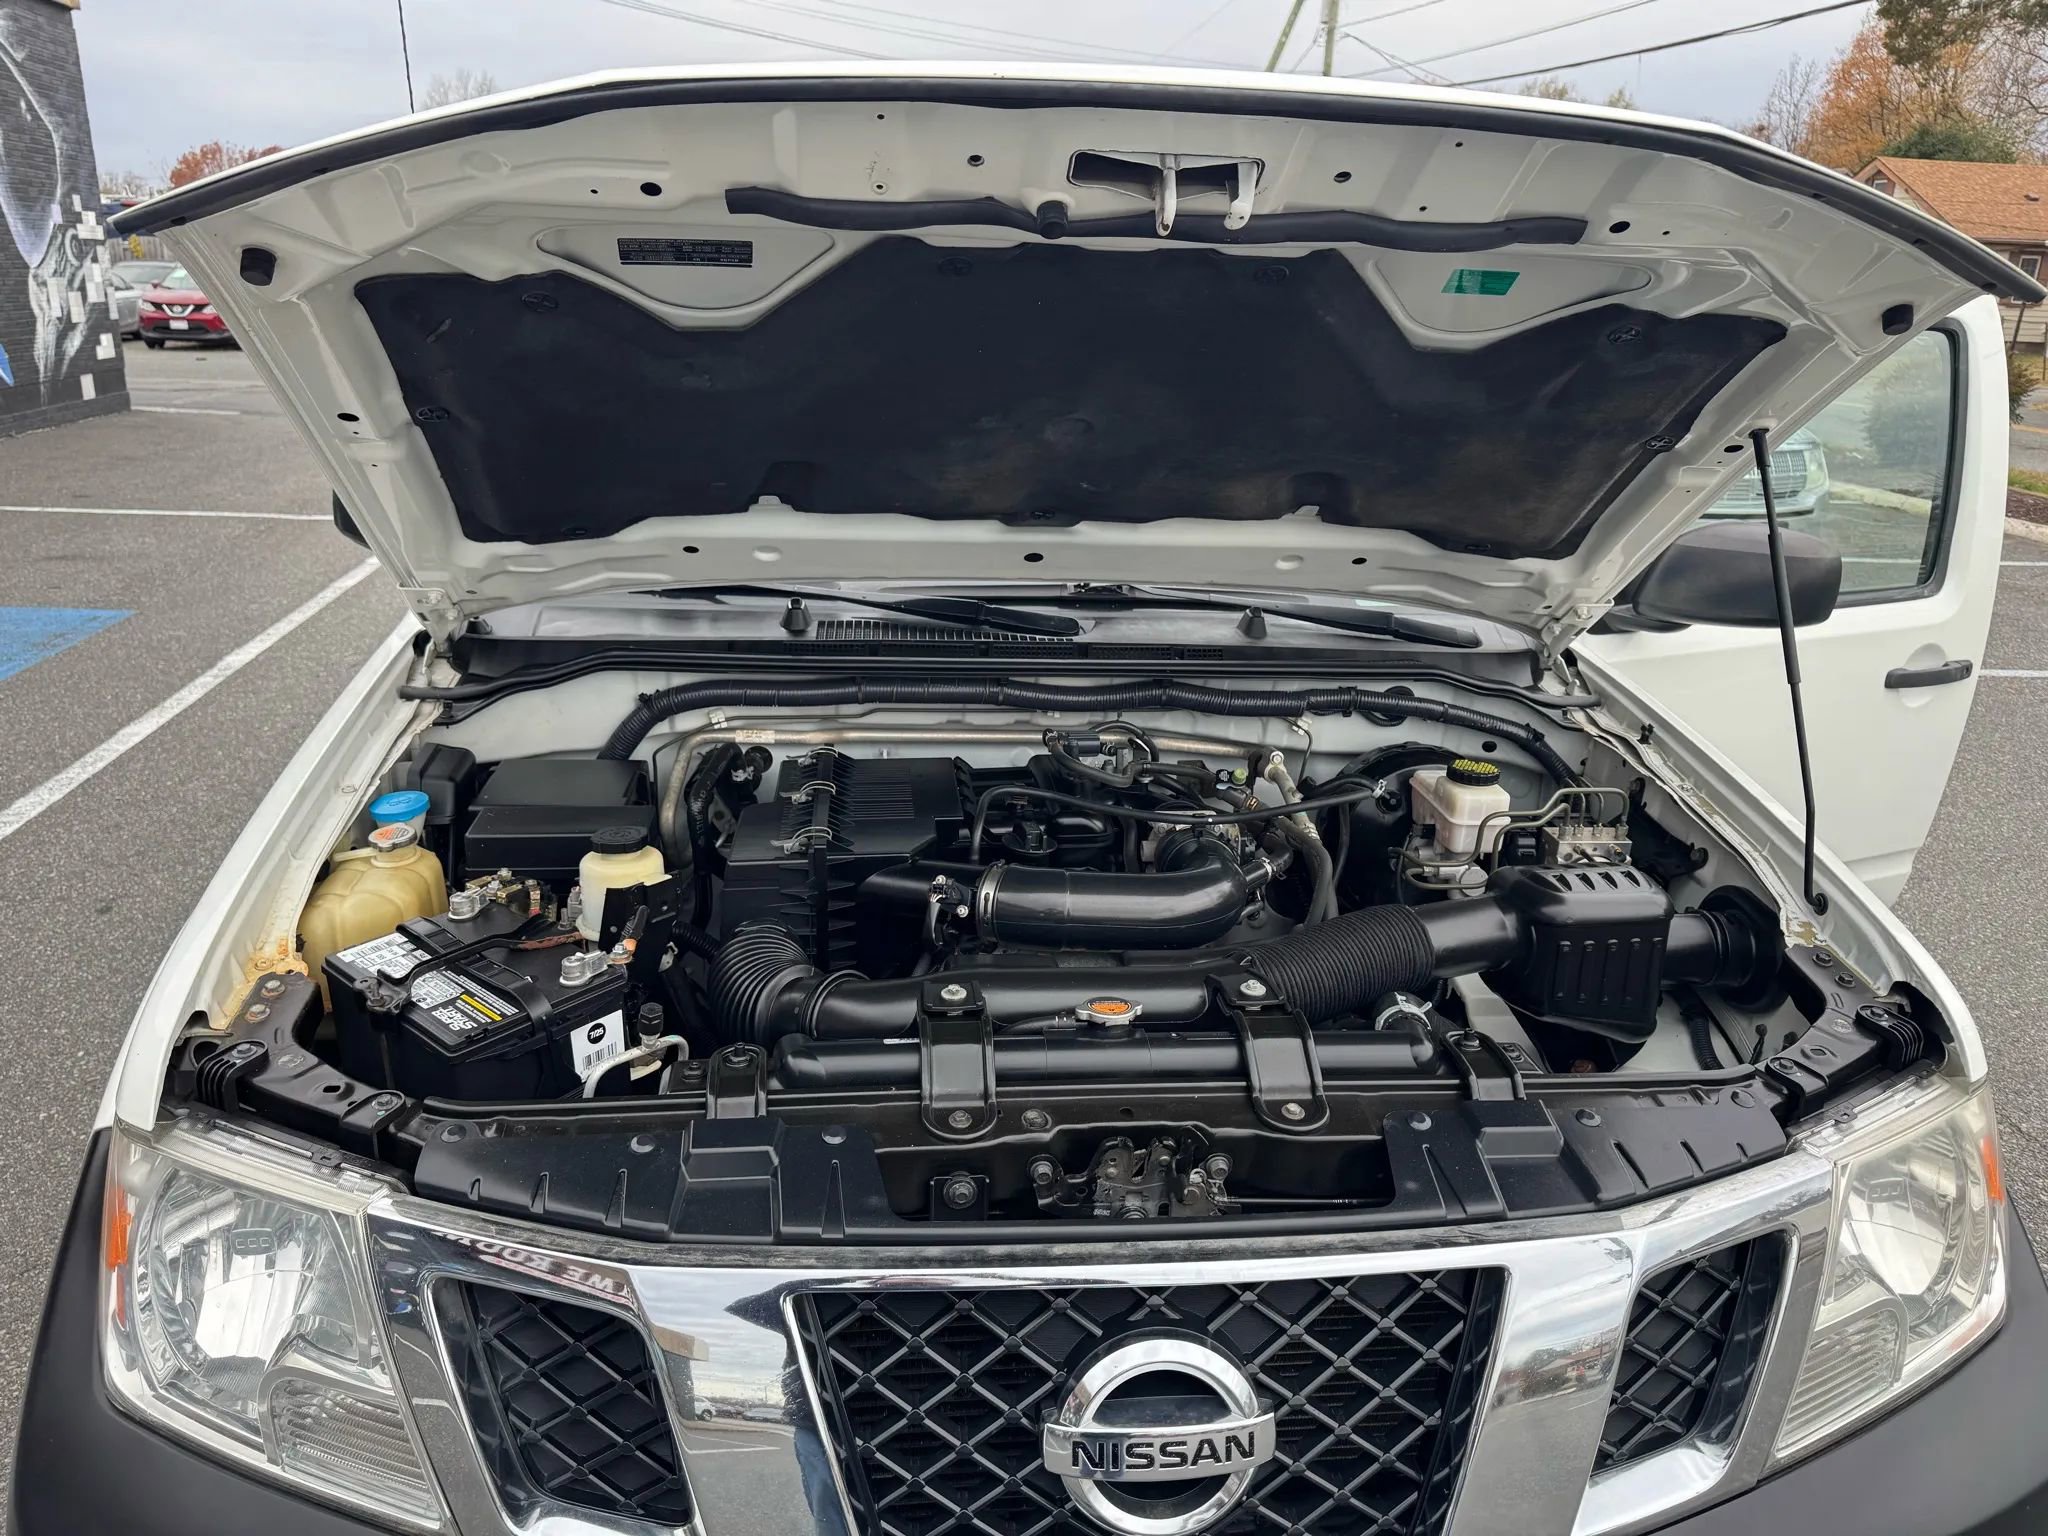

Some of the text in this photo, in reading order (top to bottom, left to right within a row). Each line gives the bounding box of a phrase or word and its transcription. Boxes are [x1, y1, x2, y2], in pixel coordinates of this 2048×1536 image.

[431, 1008, 462, 1031] SUPER
[443, 1005, 478, 1029] START
[589, 1027, 604, 1039] 7/25
[1071, 1431, 1255, 1470] NISSAN
